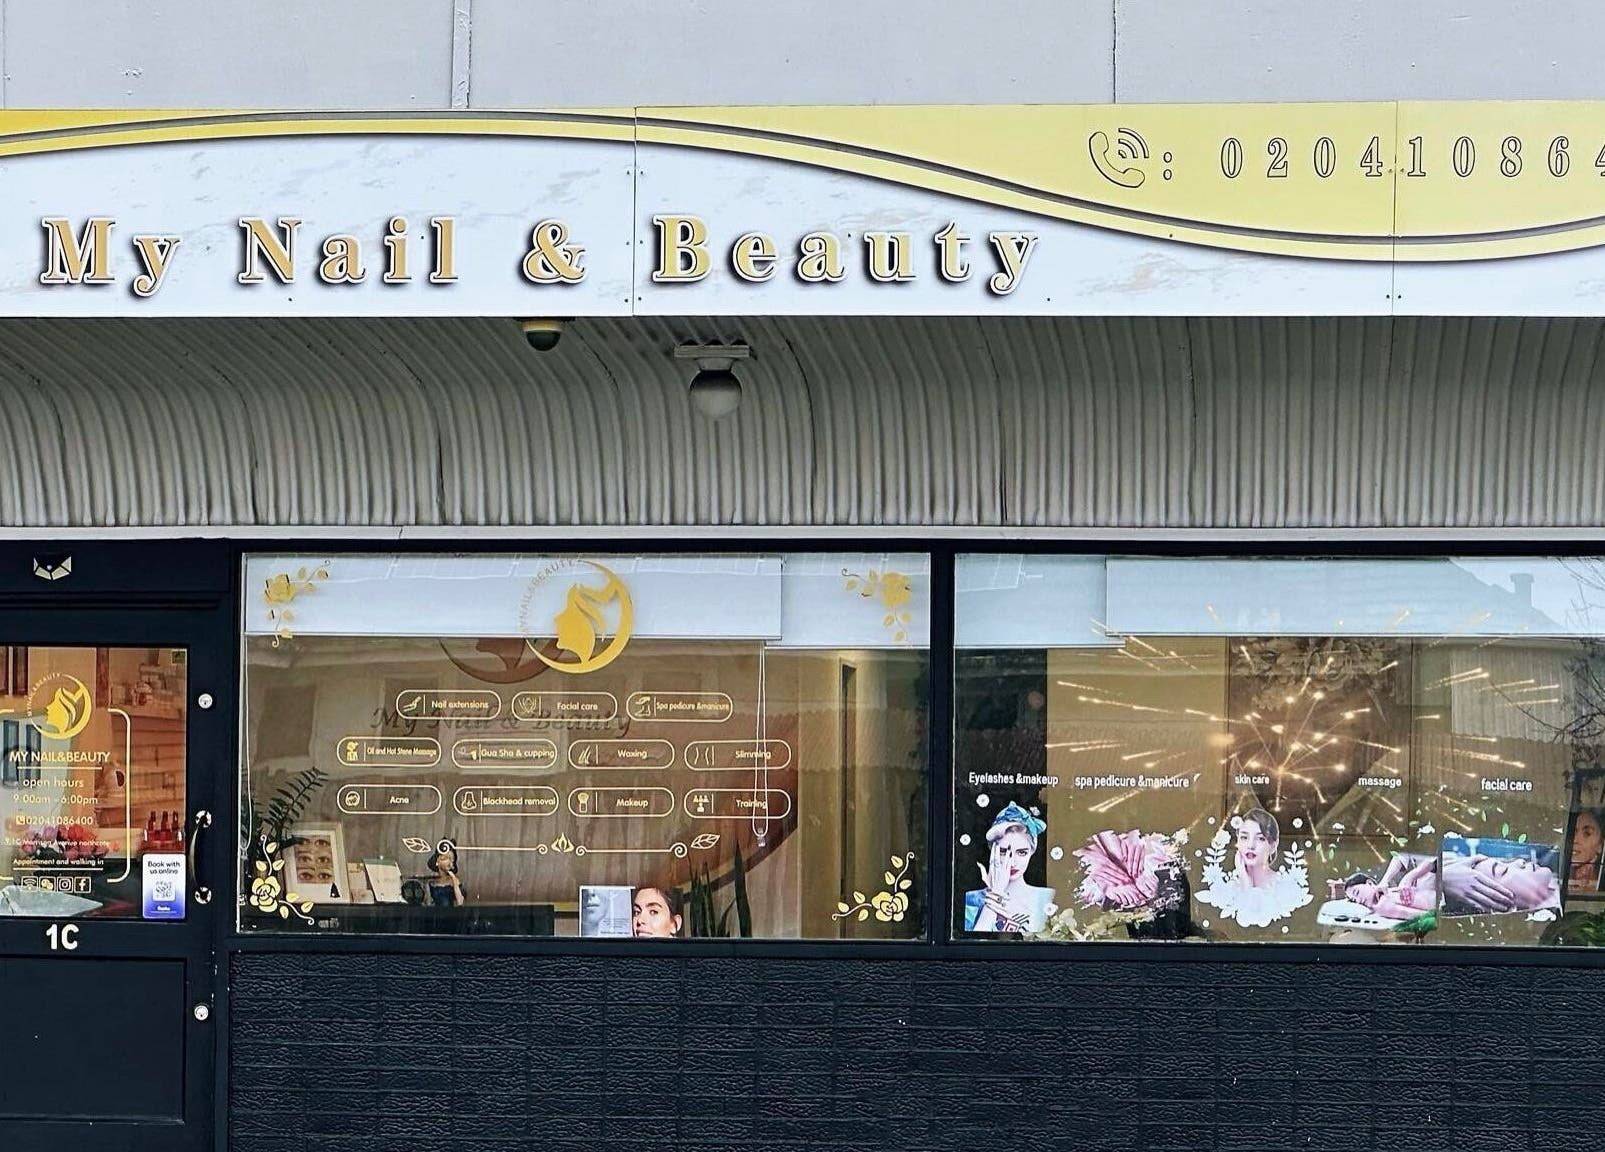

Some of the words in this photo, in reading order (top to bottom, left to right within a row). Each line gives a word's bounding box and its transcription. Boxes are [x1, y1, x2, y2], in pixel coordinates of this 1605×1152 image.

[40, 216, 181, 298] My
[237, 216, 459, 285] Nail
[520, 218, 586, 285] &
[651, 215, 1040, 296] Beauty
[431, 700, 447, 709] Nail
[448, 700, 489, 709] extensions
[557, 702, 579, 711] Facial
[581, 703, 598, 711] care
[9, 752, 29, 762] MY
[31, 752, 111, 762] NAIL&BEAUTY
[617, 749, 648, 760] Waxing
[22, 778, 51, 789] open
[53, 776, 85, 788] hours
[968, 772, 1014, 786] Eyelashes
[1016, 773, 1059, 787] &makeup
[1075, 776, 1093, 789] spa
[1094, 774, 1136, 789] pedicure
[1234, 774, 1251, 785] skin
[1252, 774, 1270, 785] care
[1358, 776, 1402, 789] massage
[1481, 778, 1508, 790] facial
[1509, 781, 1533, 791] care
[390, 796, 409, 804] Acne
[483, 797, 523, 805] Blackhead
[524, 797, 556, 806] removal
[616, 798, 649, 808] Makeup
[46, 923, 79, 950] 1C
